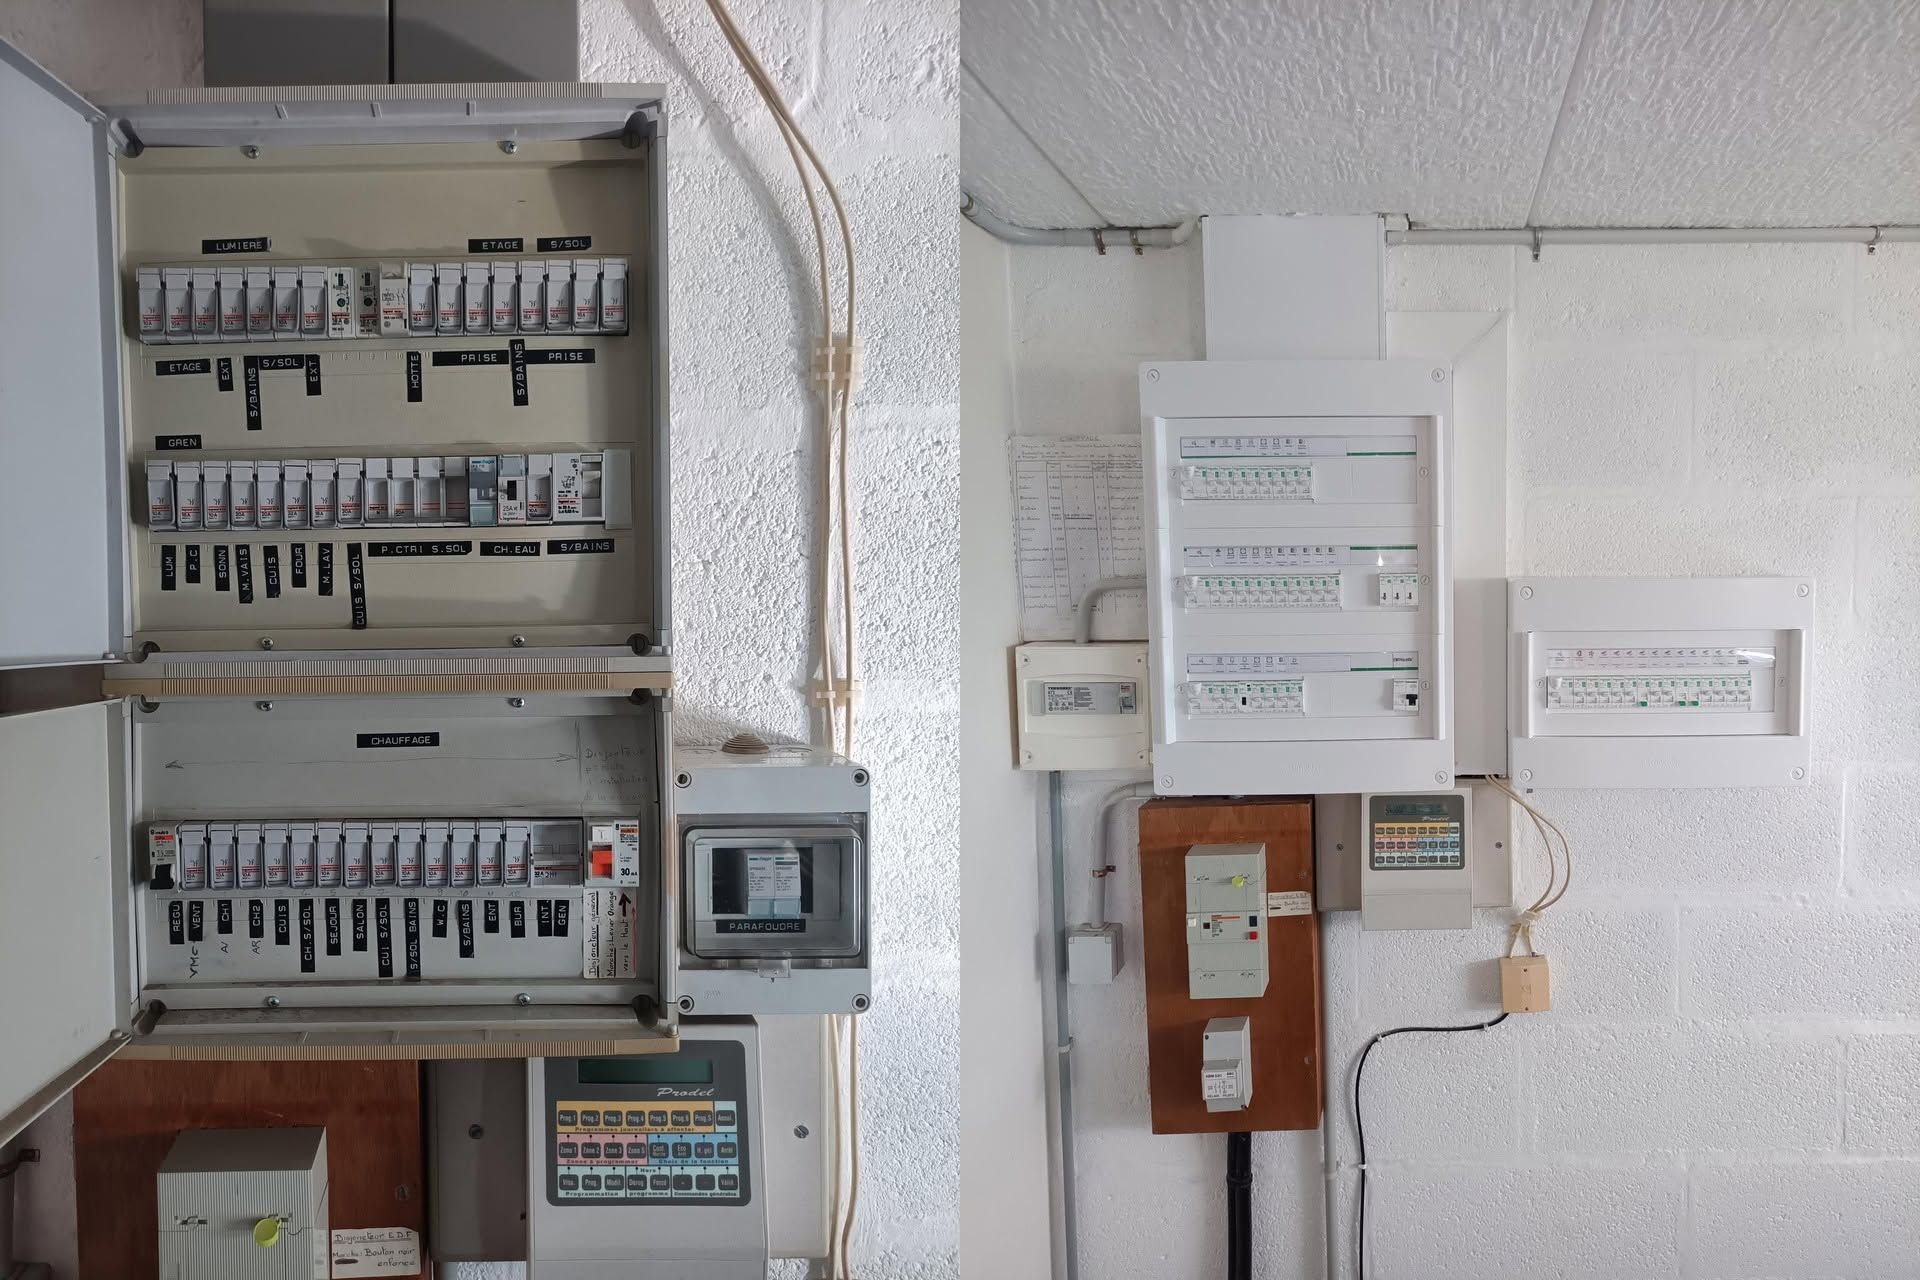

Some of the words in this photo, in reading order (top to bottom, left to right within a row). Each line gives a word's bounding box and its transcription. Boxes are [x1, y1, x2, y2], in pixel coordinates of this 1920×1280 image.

[216, 241, 263, 251] LUMIERE
[482, 241, 519, 250] ETAGE
[550, 240, 587, 249] S/SOL
[263, 358, 298, 368] S/SOL
[461, 353, 497, 362] PRISE
[548, 352, 583, 361] PRISE
[169, 363, 202, 373] ETAGE
[221, 361, 230, 381] EXT
[309, 360, 318, 382] EXT
[411, 354, 419, 389] HOTTE
[514, 343, 525, 396] S/BAINS
[248, 367, 258, 417] S/BAINS
[431, 544, 467, 553] S.SOL
[493, 545, 536, 554] CH.EAU
[560, 541, 610, 552] S/BAINS
[165, 556, 174, 577] LUM
[189, 549, 198, 571] P.C
[218, 549, 227, 579] SONN
[239, 548, 250, 591] M.VAIS
[267, 556, 278, 585] CUIS
[295, 547, 303, 575] FOUR
[321, 547, 330, 584] M.LAV
[352, 553, 362, 590] S/SOL
[355, 596, 365, 626] CUIS
[371, 735, 431, 745] CHAUFFAGE
[620, 868, 630, 876] 30
[221, 904, 230, 922] CH1
[488, 903, 497, 921] ENT
[608, 890, 617, 917] Orange
[172, 904, 181, 932] REGU
[192, 904, 201, 929] VENT
[252, 905, 261, 927] CH2
[278, 905, 287, 933] CUIS
[329, 905, 338, 944] SEJOUR
[356, 904, 365, 939] SALON
[380, 904, 388, 938] S/SOL
[409, 901, 417, 932] BAINS
[436, 904, 446, 926] W.C
[461, 903, 471, 946] S/BAINS
[514, 906, 522, 926] BUR
[558, 905, 567, 926] GEN
[302, 905, 312, 961] CH.S/SOL
[729, 922, 800, 931] PARAFOUDRE
[251, 939, 261, 955] AR
[381, 946, 390, 966] CUI
[409, 939, 418, 970] S/SOL
[189, 946, 199, 979] VMC
[656, 1087, 715, 1097] Prodel
[364, 1246, 395, 1257] Bouton
